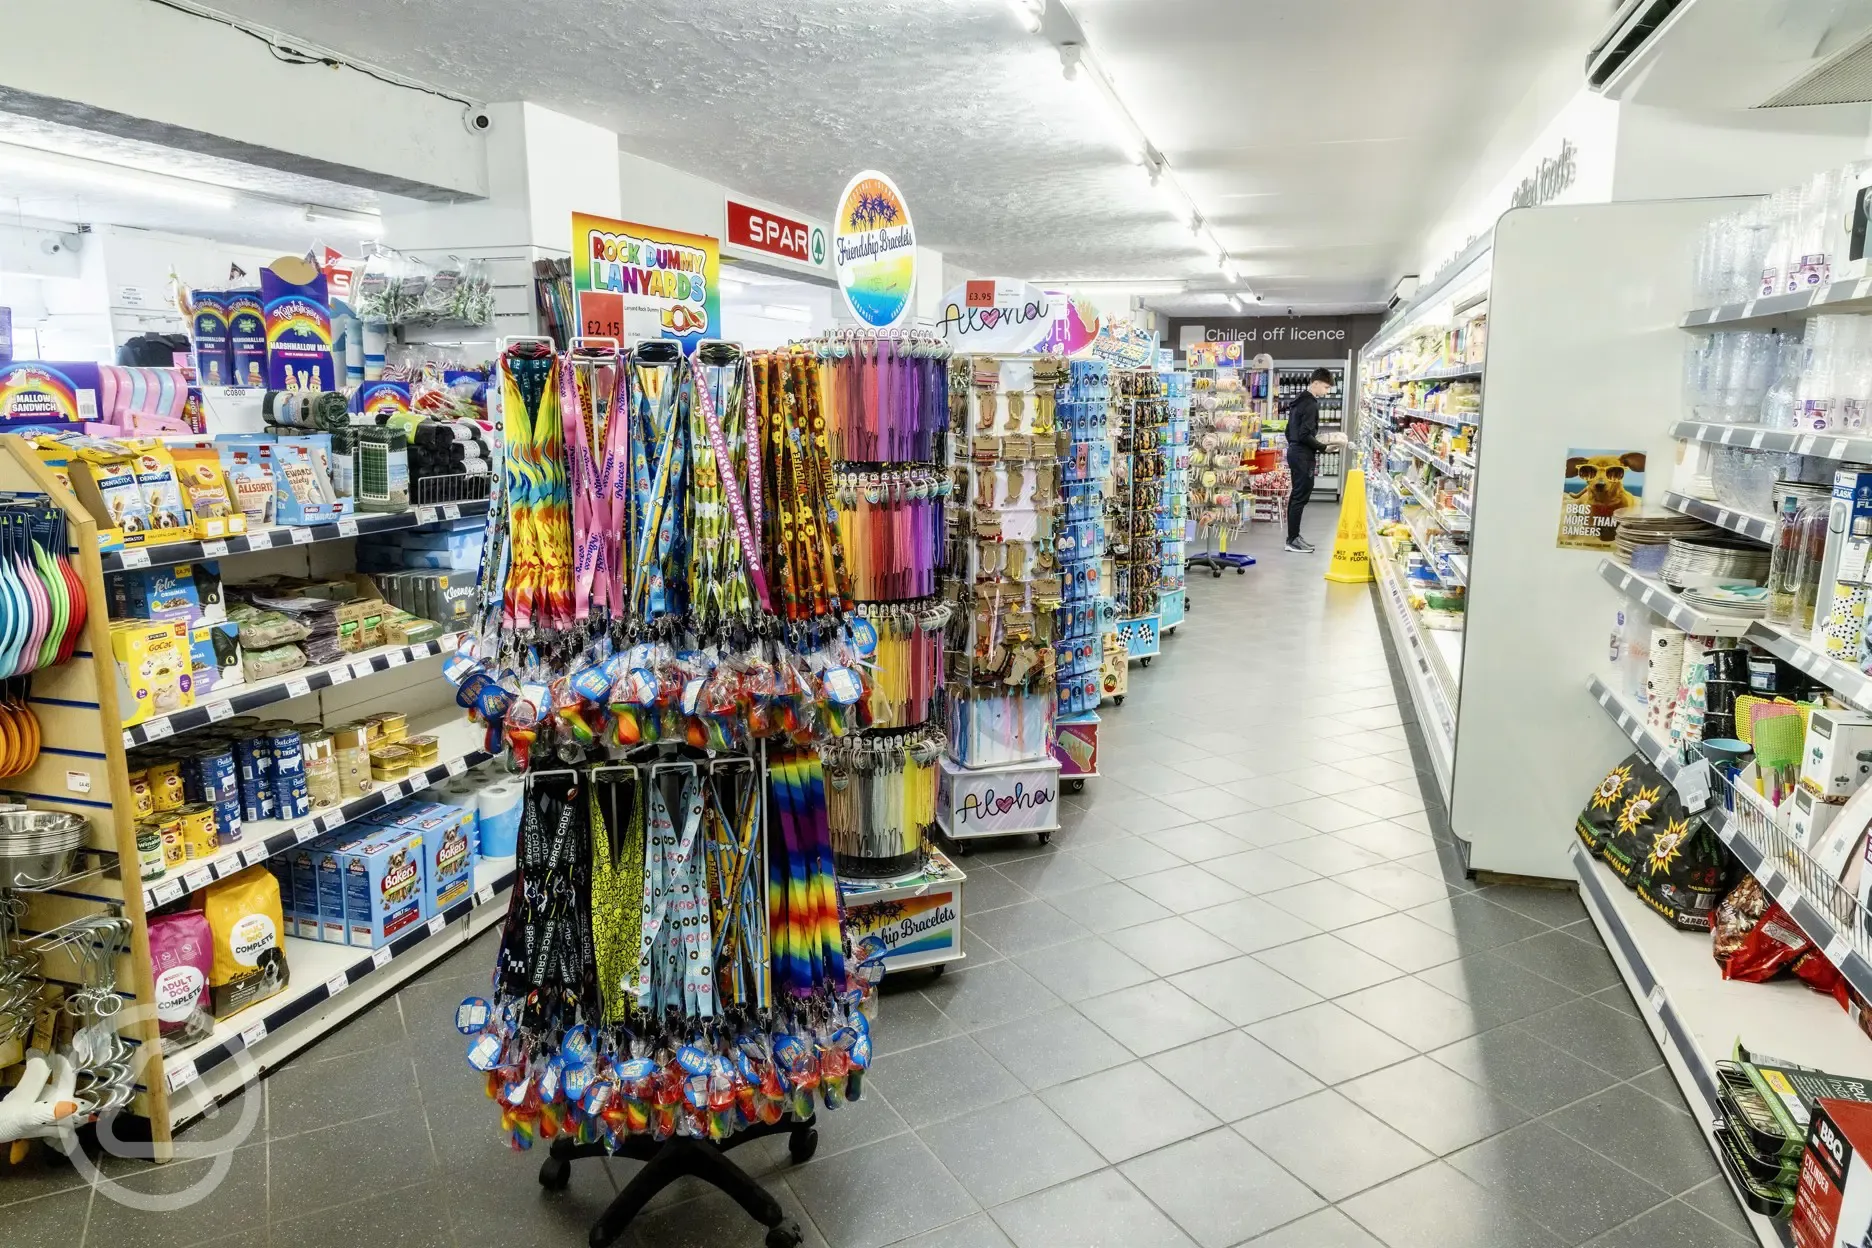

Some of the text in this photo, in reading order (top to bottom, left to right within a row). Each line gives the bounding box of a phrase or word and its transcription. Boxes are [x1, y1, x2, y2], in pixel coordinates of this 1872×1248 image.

[749, 215, 808, 255] SPAR
[593, 236, 703, 273] ROCK DUMMY
[837, 226, 913, 266] Friendship Bracelets
[593, 262, 704, 302] LANYARDS
[969, 293, 992, 301] £3.95
[587, 320, 620, 336] £2.15
[1206, 327, 1345, 341] Chilled off licence
[270, 342, 316, 351] MARSHMALLOW
[12, 402, 57, 412] SANDWICH
[16, 394, 53, 403] MALLOW
[100, 475, 134, 488] DENTASTIX
[139, 471, 171, 482] DENTASTIX
[238, 483, 273, 494] ALLSORTS
[1833, 489, 1852, 500] FLASK
[304, 512, 338, 522] REWARDS
[1566, 504, 1592, 514] BBQS
[1564, 516, 1617, 528] MORE THAN
[1562, 526, 1602, 536] BANGERS
[154, 577, 176, 596] felix
[160, 589, 187, 598] ORIGINAL
[444, 586, 475, 603] Kleenex
[956, 782, 1055, 824] Aloha
[548, 804, 572, 868] SPACE CADET
[439, 839, 466, 862] Bakers
[532, 834, 540, 864] CADET
[384, 865, 415, 889] Bakers
[900, 907, 956, 938] Bracelets
[1679, 914, 1709, 927] CARBO
[236, 932, 274, 954] COMPLETE
[533, 921, 554, 985] SPACE CADET
[162, 975, 192, 994] ADULT
[169, 985, 190, 998] DOG
[158, 985, 202, 1010] COMPLETE
[1820, 1120, 1844, 1166] BBQ
[1804, 1153, 1829, 1195] CYLINDER
